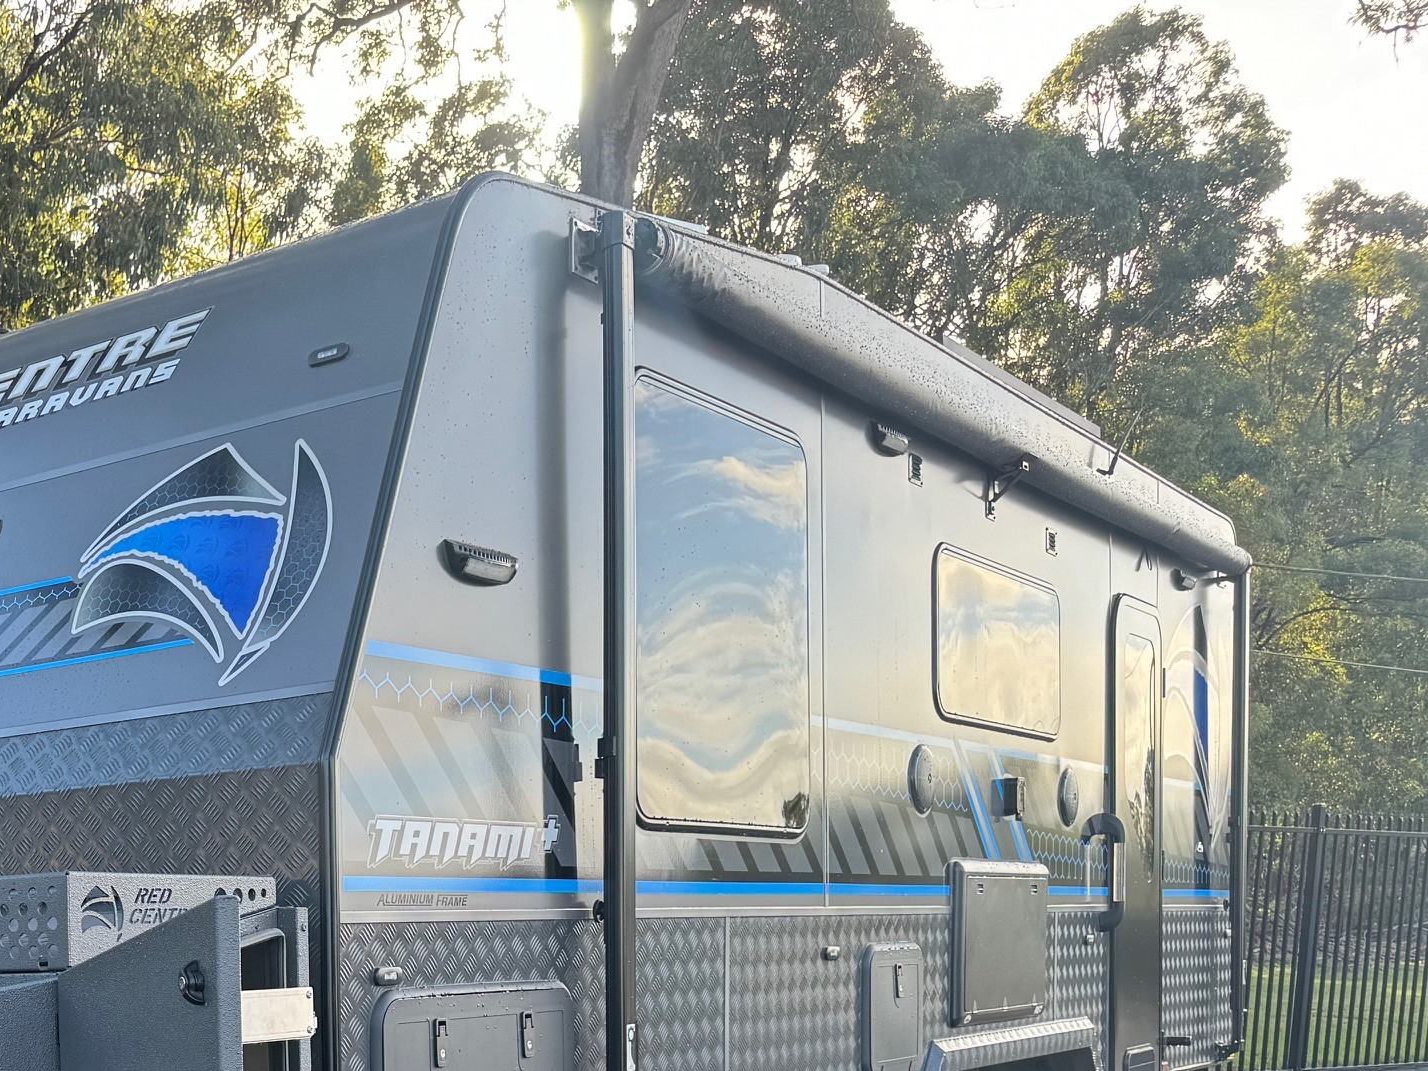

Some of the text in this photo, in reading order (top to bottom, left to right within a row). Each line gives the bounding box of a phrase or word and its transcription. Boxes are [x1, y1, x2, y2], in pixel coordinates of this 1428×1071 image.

[134, 887, 172, 904] RED
[376, 893, 468, 907] ALUMINIUM FRAME
